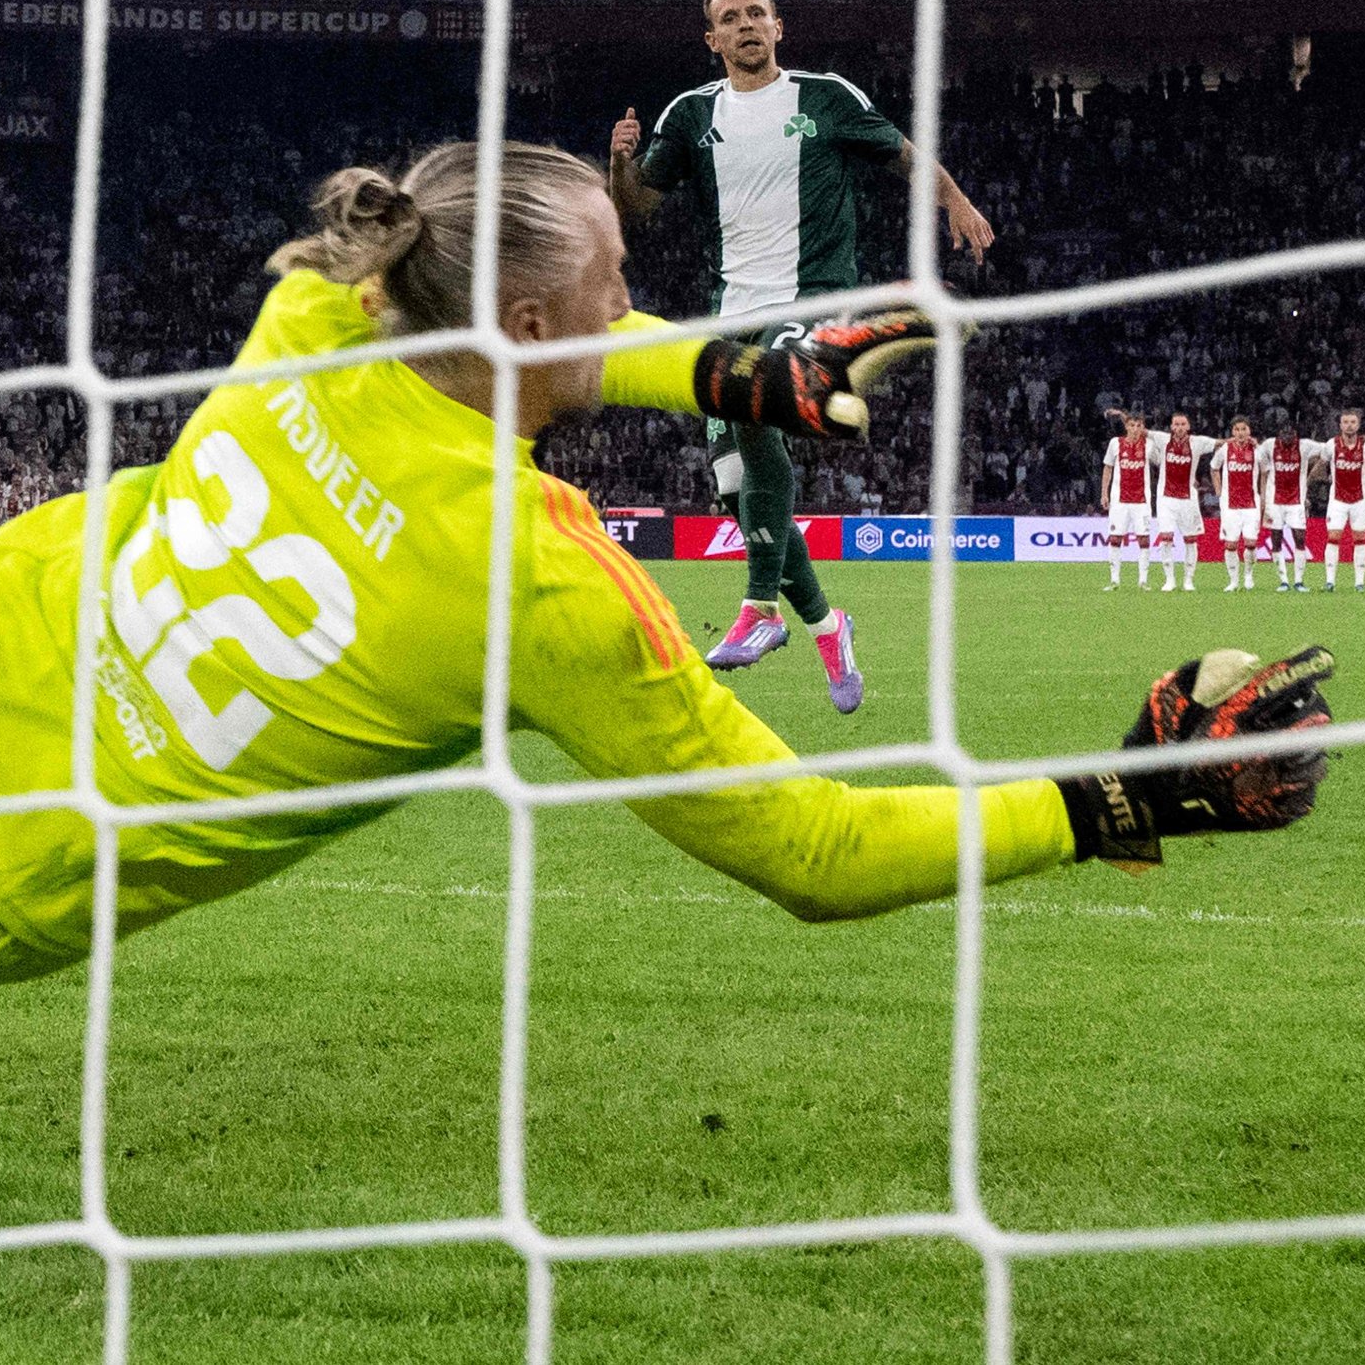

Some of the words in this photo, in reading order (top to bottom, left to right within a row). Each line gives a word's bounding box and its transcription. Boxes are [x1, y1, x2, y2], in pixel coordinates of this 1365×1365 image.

[217, 9, 391, 35] SUPERCUP
[256, 377, 406, 562] ASVEER
[601, 520, 640, 542] ET
[890, 529, 1001, 549] Coinerce
[1030, 531, 1175, 548] OLYMPA
[110, 430, 357, 772] 22
